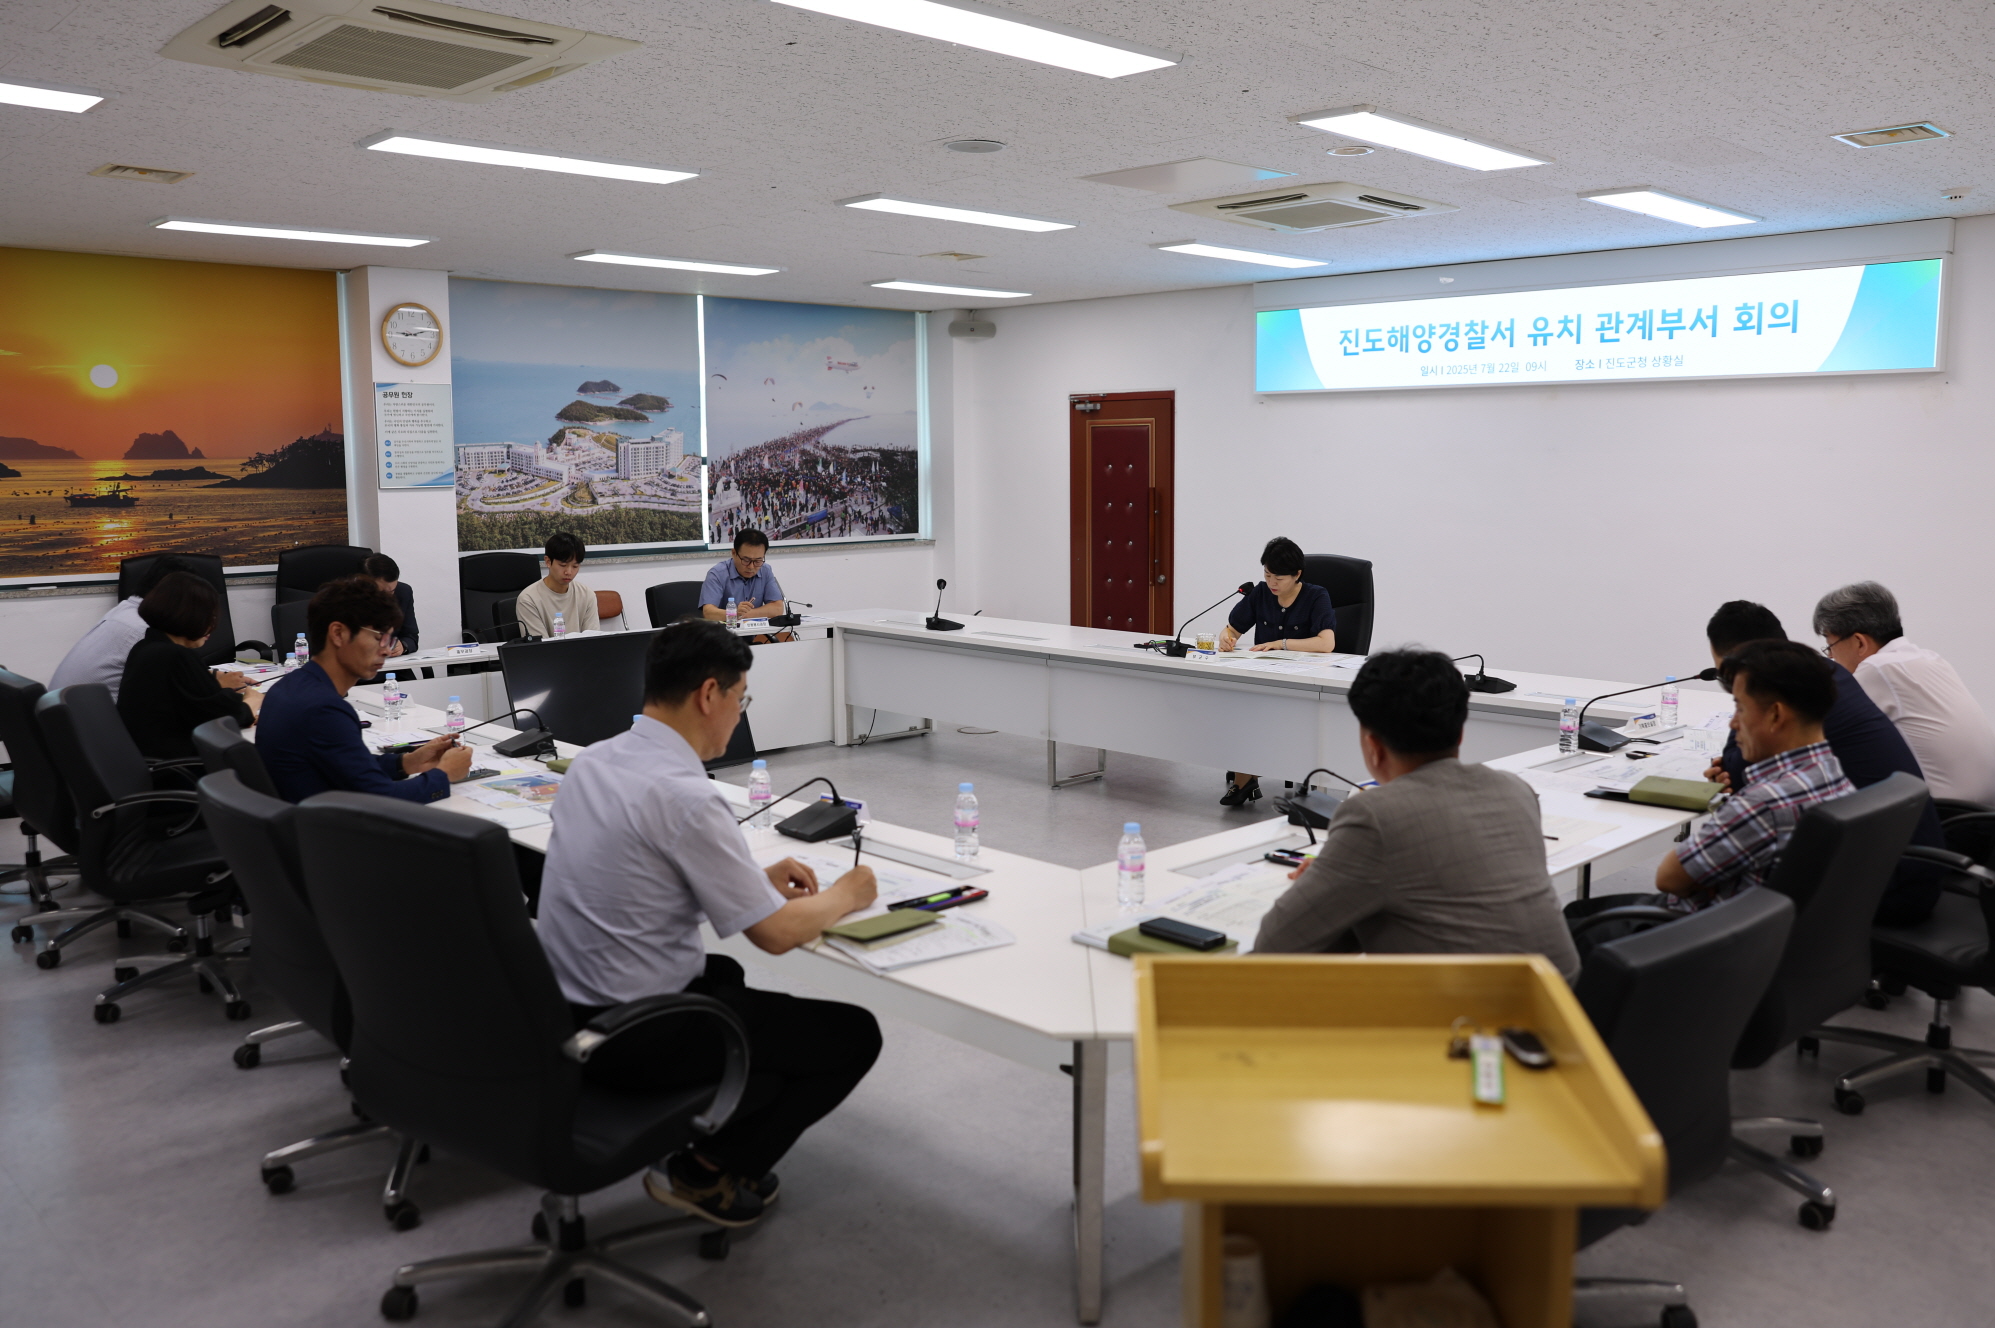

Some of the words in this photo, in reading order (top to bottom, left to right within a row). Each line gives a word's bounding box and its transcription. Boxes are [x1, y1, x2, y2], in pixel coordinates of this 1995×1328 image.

[1339, 318, 1515, 356] 진도해양경찰서
[1527, 314, 1582, 347] 유치
[1595, 305, 1718, 343] 관계부서
[1733, 299, 1799, 336] 회의
[1420, 365, 1438, 377] 일시
[1446, 363, 1478, 375] 2025년
[1481, 362, 1495, 374] 7월
[1499, 361, 1519, 373] 22일
[1525, 360, 1547, 372] 09시
[1575, 358, 1595, 371] 장소
[1605, 356, 1647, 370] 진도군청
[1651, 354, 1684, 368] 상황실
[382, 391, 399, 399] 공무원
[401, 391, 413, 399] 헌장
